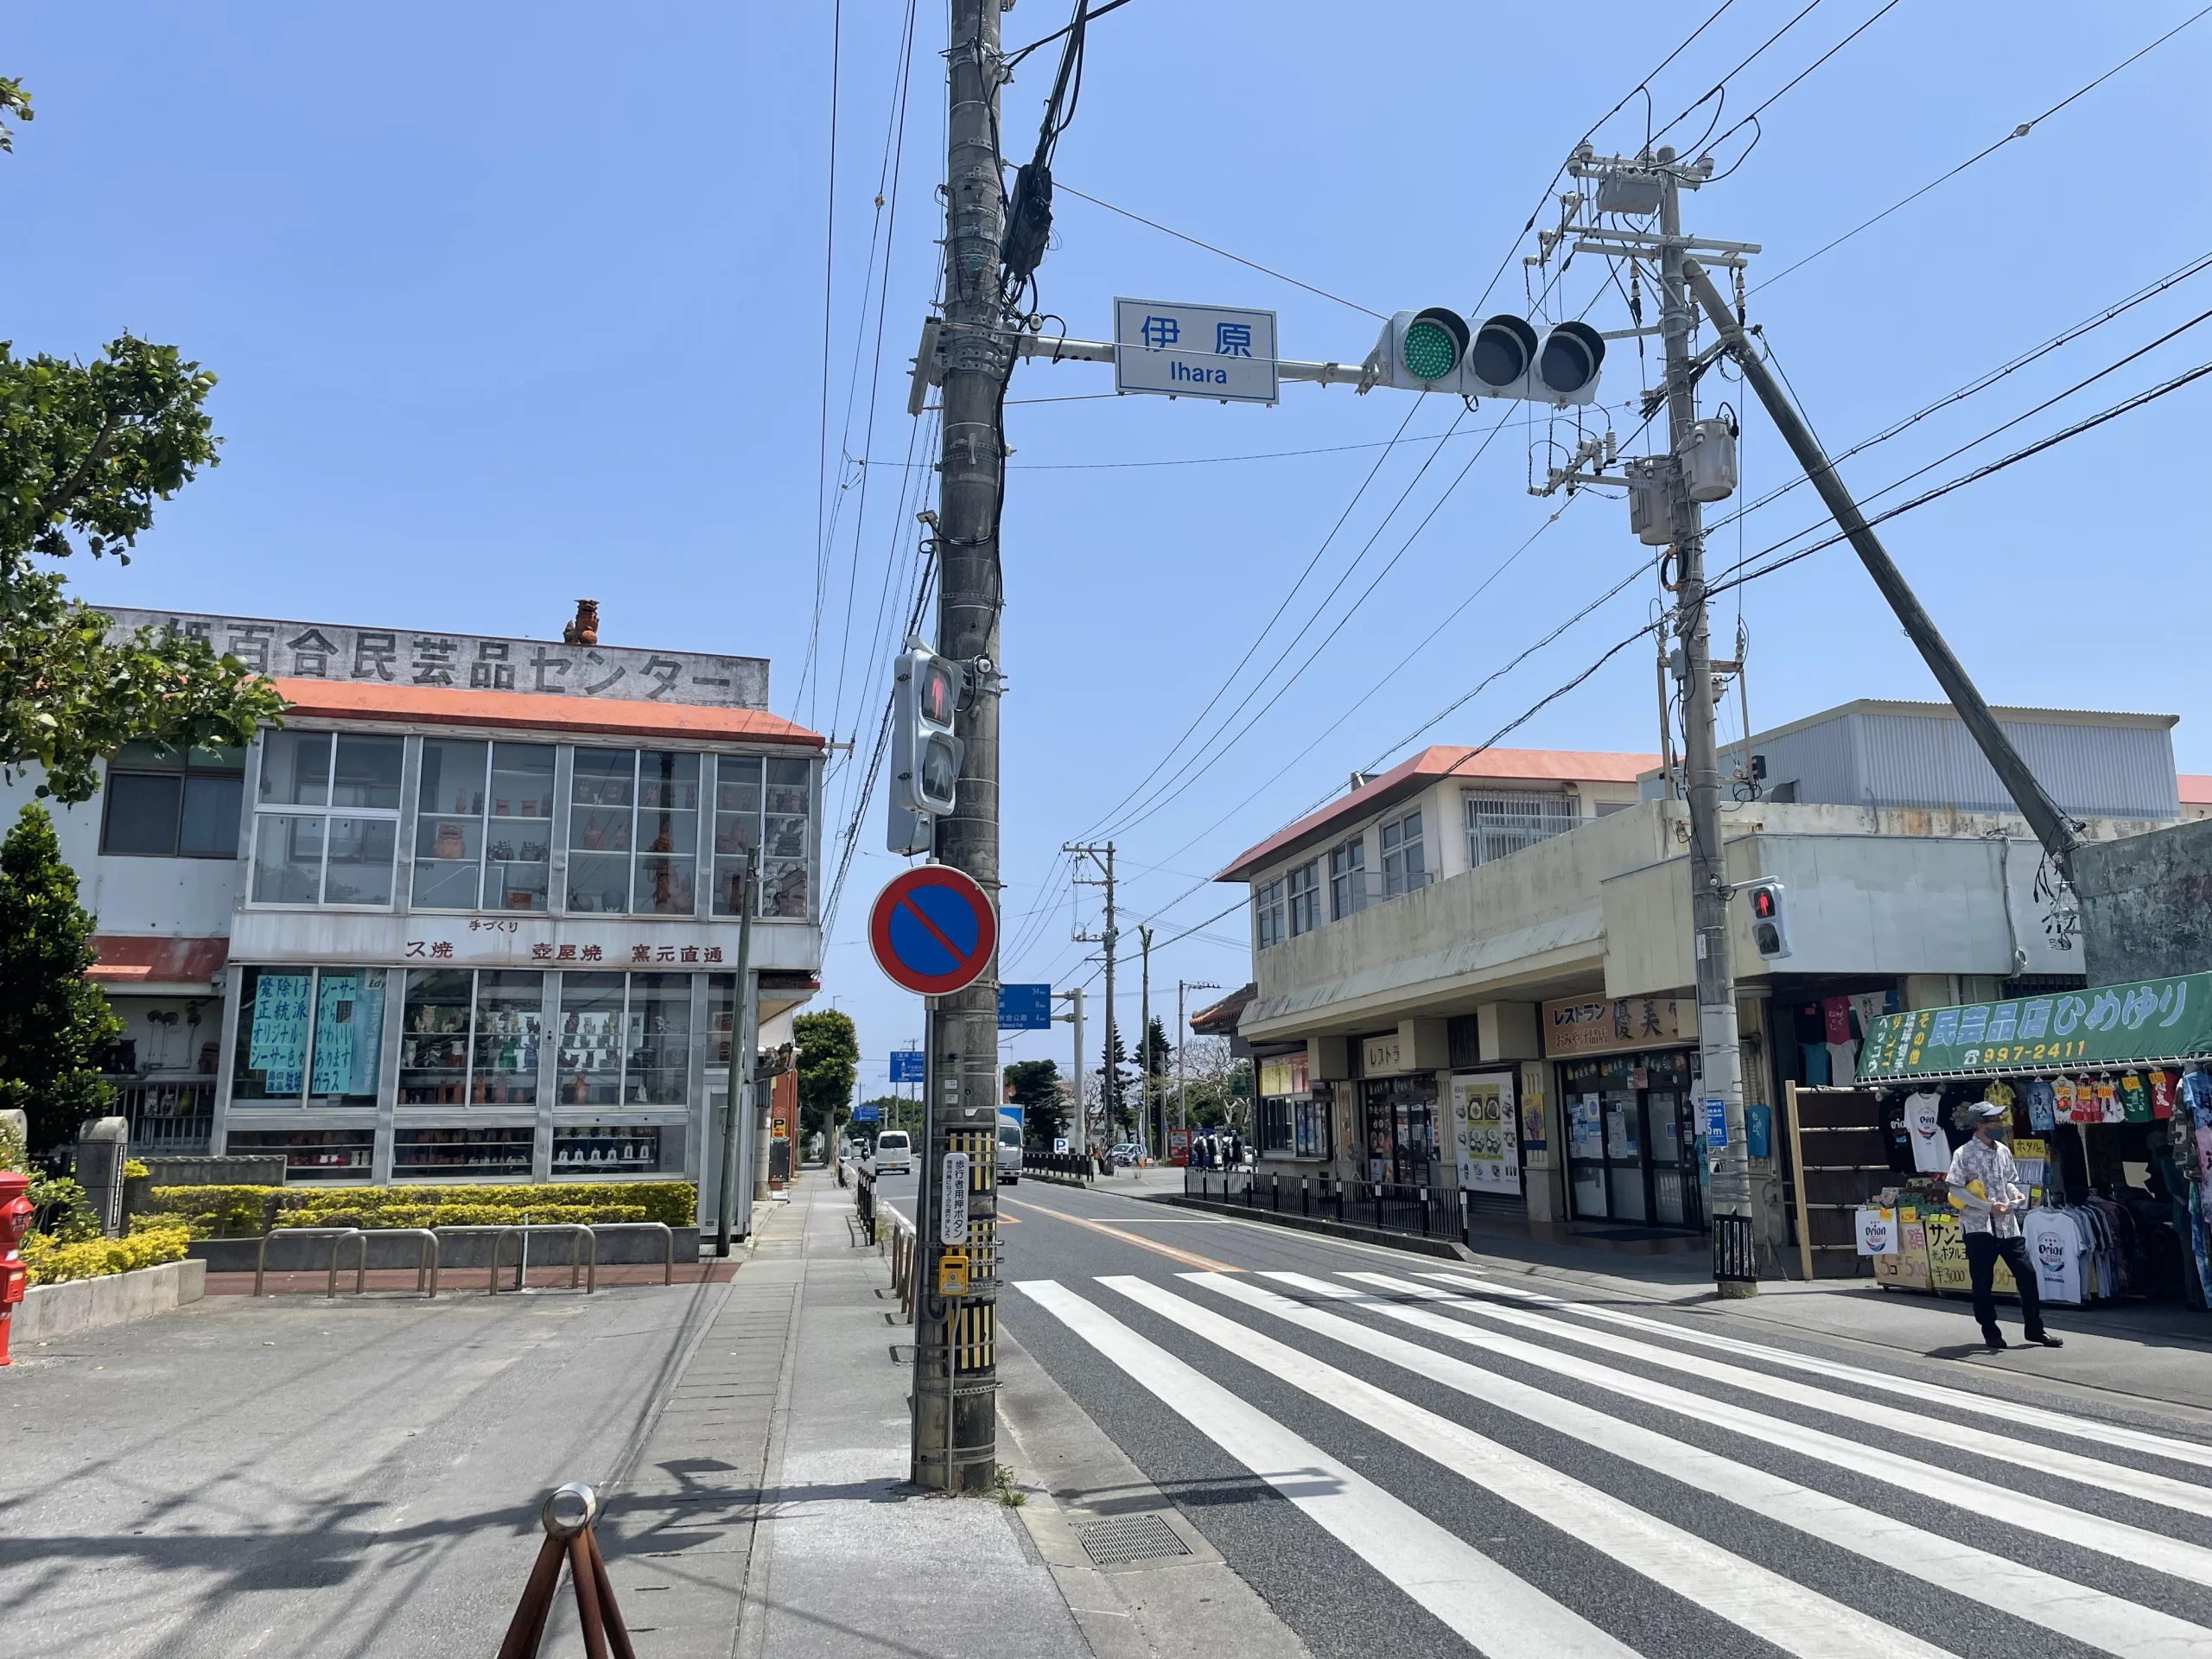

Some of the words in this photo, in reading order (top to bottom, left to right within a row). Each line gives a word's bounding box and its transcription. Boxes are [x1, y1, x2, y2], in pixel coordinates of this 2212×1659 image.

[1141, 315, 1252, 359] 伊原
[1170, 360, 1228, 385] Ihara
[468, 919, 519, 933] 手づくり
[257, 977, 311, 999] 魔除け
[321, 978, 356, 999] シーサー
[368, 978, 387, 989] Edy
[255, 999, 308, 1021] 正統派
[319, 1001, 335, 1023] から
[1554, 1002, 1606, 1027] レストラン
[1927, 981, 2187, 1048] 民芸品店ひめゆり
[1908, 1012, 1929, 1065] その他
[251, 1045, 305, 1068] シーサー色々
[315, 1046, 351, 1069] あります
[1983, 1039, 2086, 1064] 997-2411
[312, 1070, 340, 1092] ガラス
[1056, 1139, 1066, 1151] P
[953, 1160, 965, 1239] 歩行者用押ボタン
[1865, 1224, 1886, 1236] Orion
[2038, 1243, 2064, 1256] Orion
